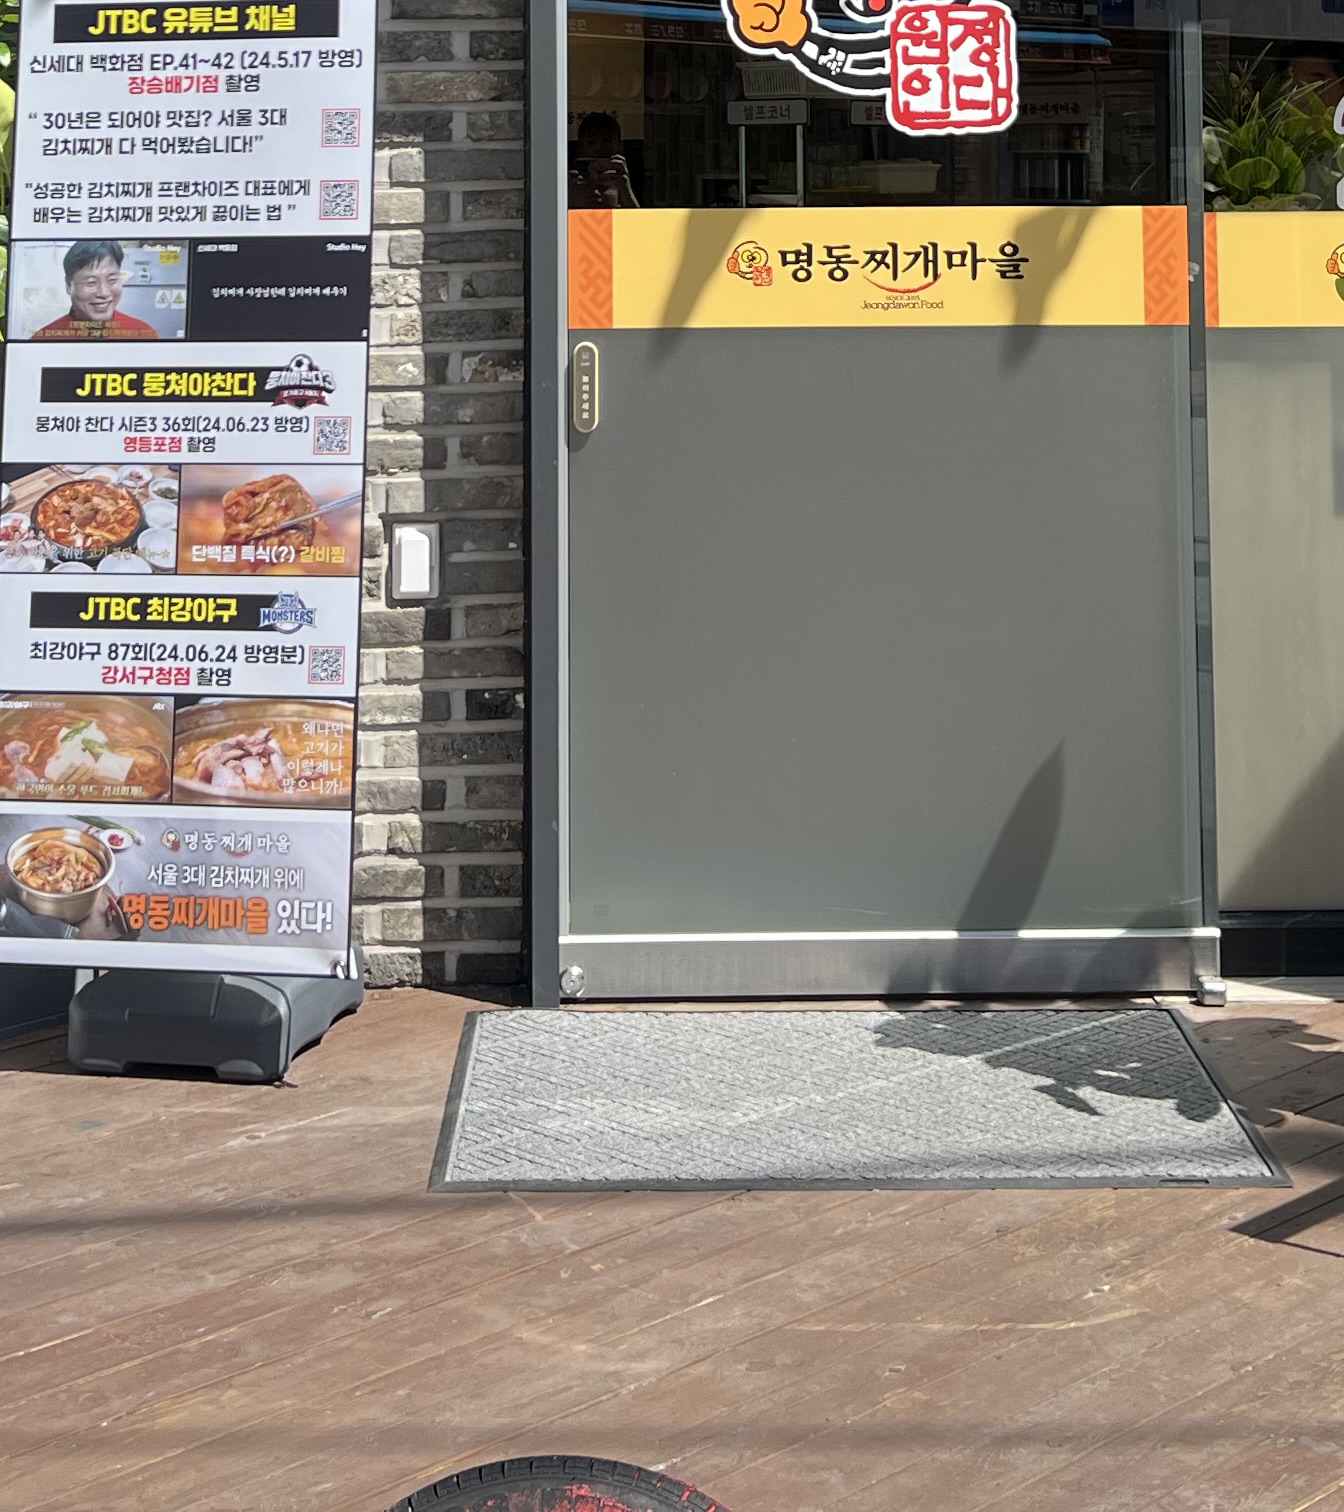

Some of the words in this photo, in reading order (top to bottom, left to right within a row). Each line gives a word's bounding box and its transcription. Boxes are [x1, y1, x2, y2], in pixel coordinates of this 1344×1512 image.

[87, 7, 157, 36] JTBC
[162, 5, 239, 34] 유튜브
[244, 3, 297, 32] 채널
[29, 54, 84, 75] 신세대
[89, 52, 144, 72] 백화점
[150, 51, 234, 71] EP.41~42
[318, 49, 363, 69] 방영)
[128, 74, 220, 95] 장승배기점
[225, 73, 262, 93] 촬영
[42, 111, 102, 130] 30년은
[107, 111, 162, 129] 되어야
[166, 109, 212, 128] 맛집?
[217, 108, 253, 128] 서울
[258, 107, 288, 126] 3대
[742, 103, 792, 121] 셀프코너
[42, 137, 113, 156] 김치찌개
[118, 138, 136, 156] 다
[87, 181, 153, 199] 김치찌개
[157, 180, 241, 198] 프랜차이즈
[244, 178, 311, 197] 대표에게
[33, 206, 83, 224] 배우는
[87, 205, 153, 223] 김치찌개
[157, 205, 207, 223] 맛있게
[211, 204, 262, 223] 끓이는
[266, 204, 282, 222] 법
[777, 241, 1030, 284] 명동찌개마을
[75, 373, 137, 398] JTBC
[142, 371, 257, 398] 뭉쳐야찬다
[35, 416, 82, 434] 뭉쳐야
[85, 416, 115, 433] 찬다
[118, 416, 158, 433] 시즌3
[274, 415, 311, 434] 방영)
[123, 435, 182, 454] 영등포점
[186, 435, 217, 453] 촬영
[191, 543, 238, 564] 단백질
[299, 543, 346, 564] 갈비찜
[79, 596, 141, 622] JTBC
[146, 596, 238, 623] 최강야구
[261, 608, 315, 626] MONSTERS
[29, 641, 102, 661] 최강야구
[243, 643, 306, 665] 방영분)
[101, 665, 191, 686] 강서구청점
[196, 666, 233, 687] 촬영
[146, 863, 178, 888] 서울
[181, 863, 206, 888] 3대
[209, 864, 270, 890] 김치찌개
[273, 866, 304, 891] 위에
[122, 895, 271, 936] 명동찌개마을
[276, 898, 333, 936] 있다!
